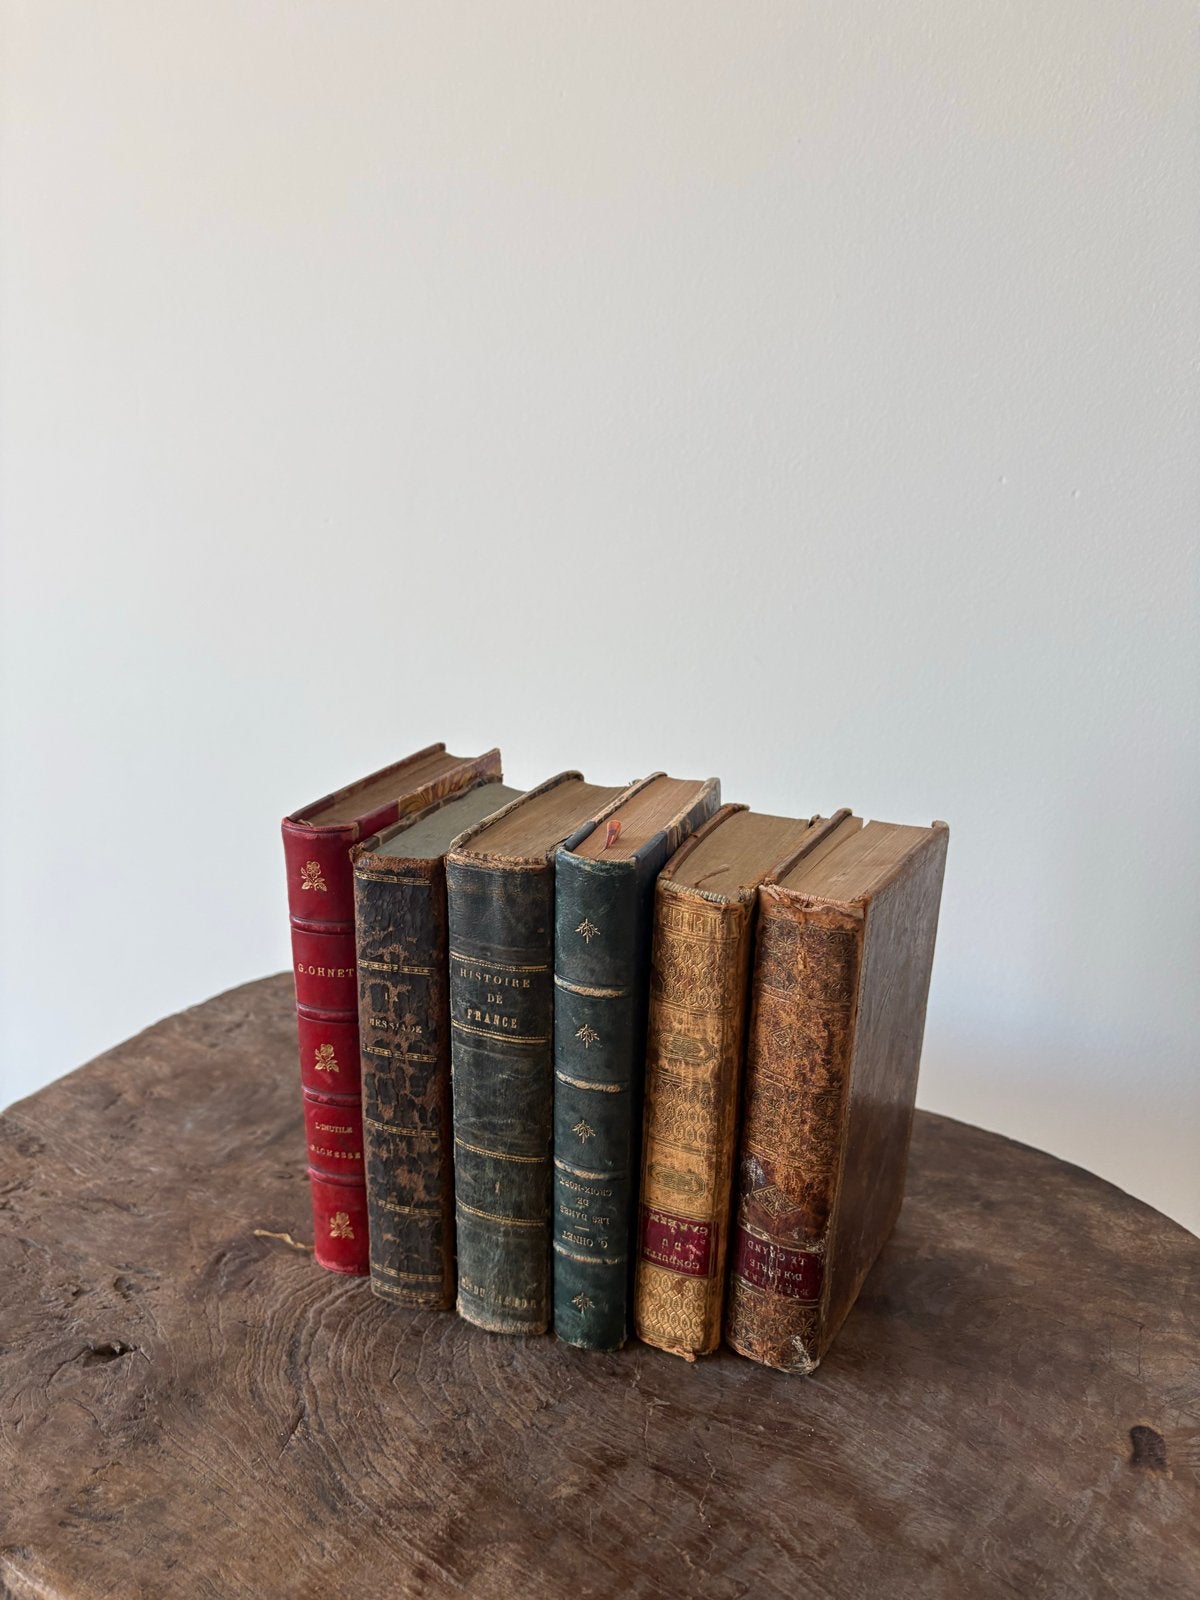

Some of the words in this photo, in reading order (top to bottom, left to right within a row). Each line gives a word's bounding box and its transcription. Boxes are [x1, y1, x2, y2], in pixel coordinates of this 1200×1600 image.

[460, 968, 531, 988] HISTOIRE
[467, 1008, 518, 1029] FRANCE
[576, 1197, 589, 1207] DE
[560, 1205, 588, 1221] DAMES
[592, 1215, 610, 1225] LES
[561, 1231, 594, 1247] OHNET
